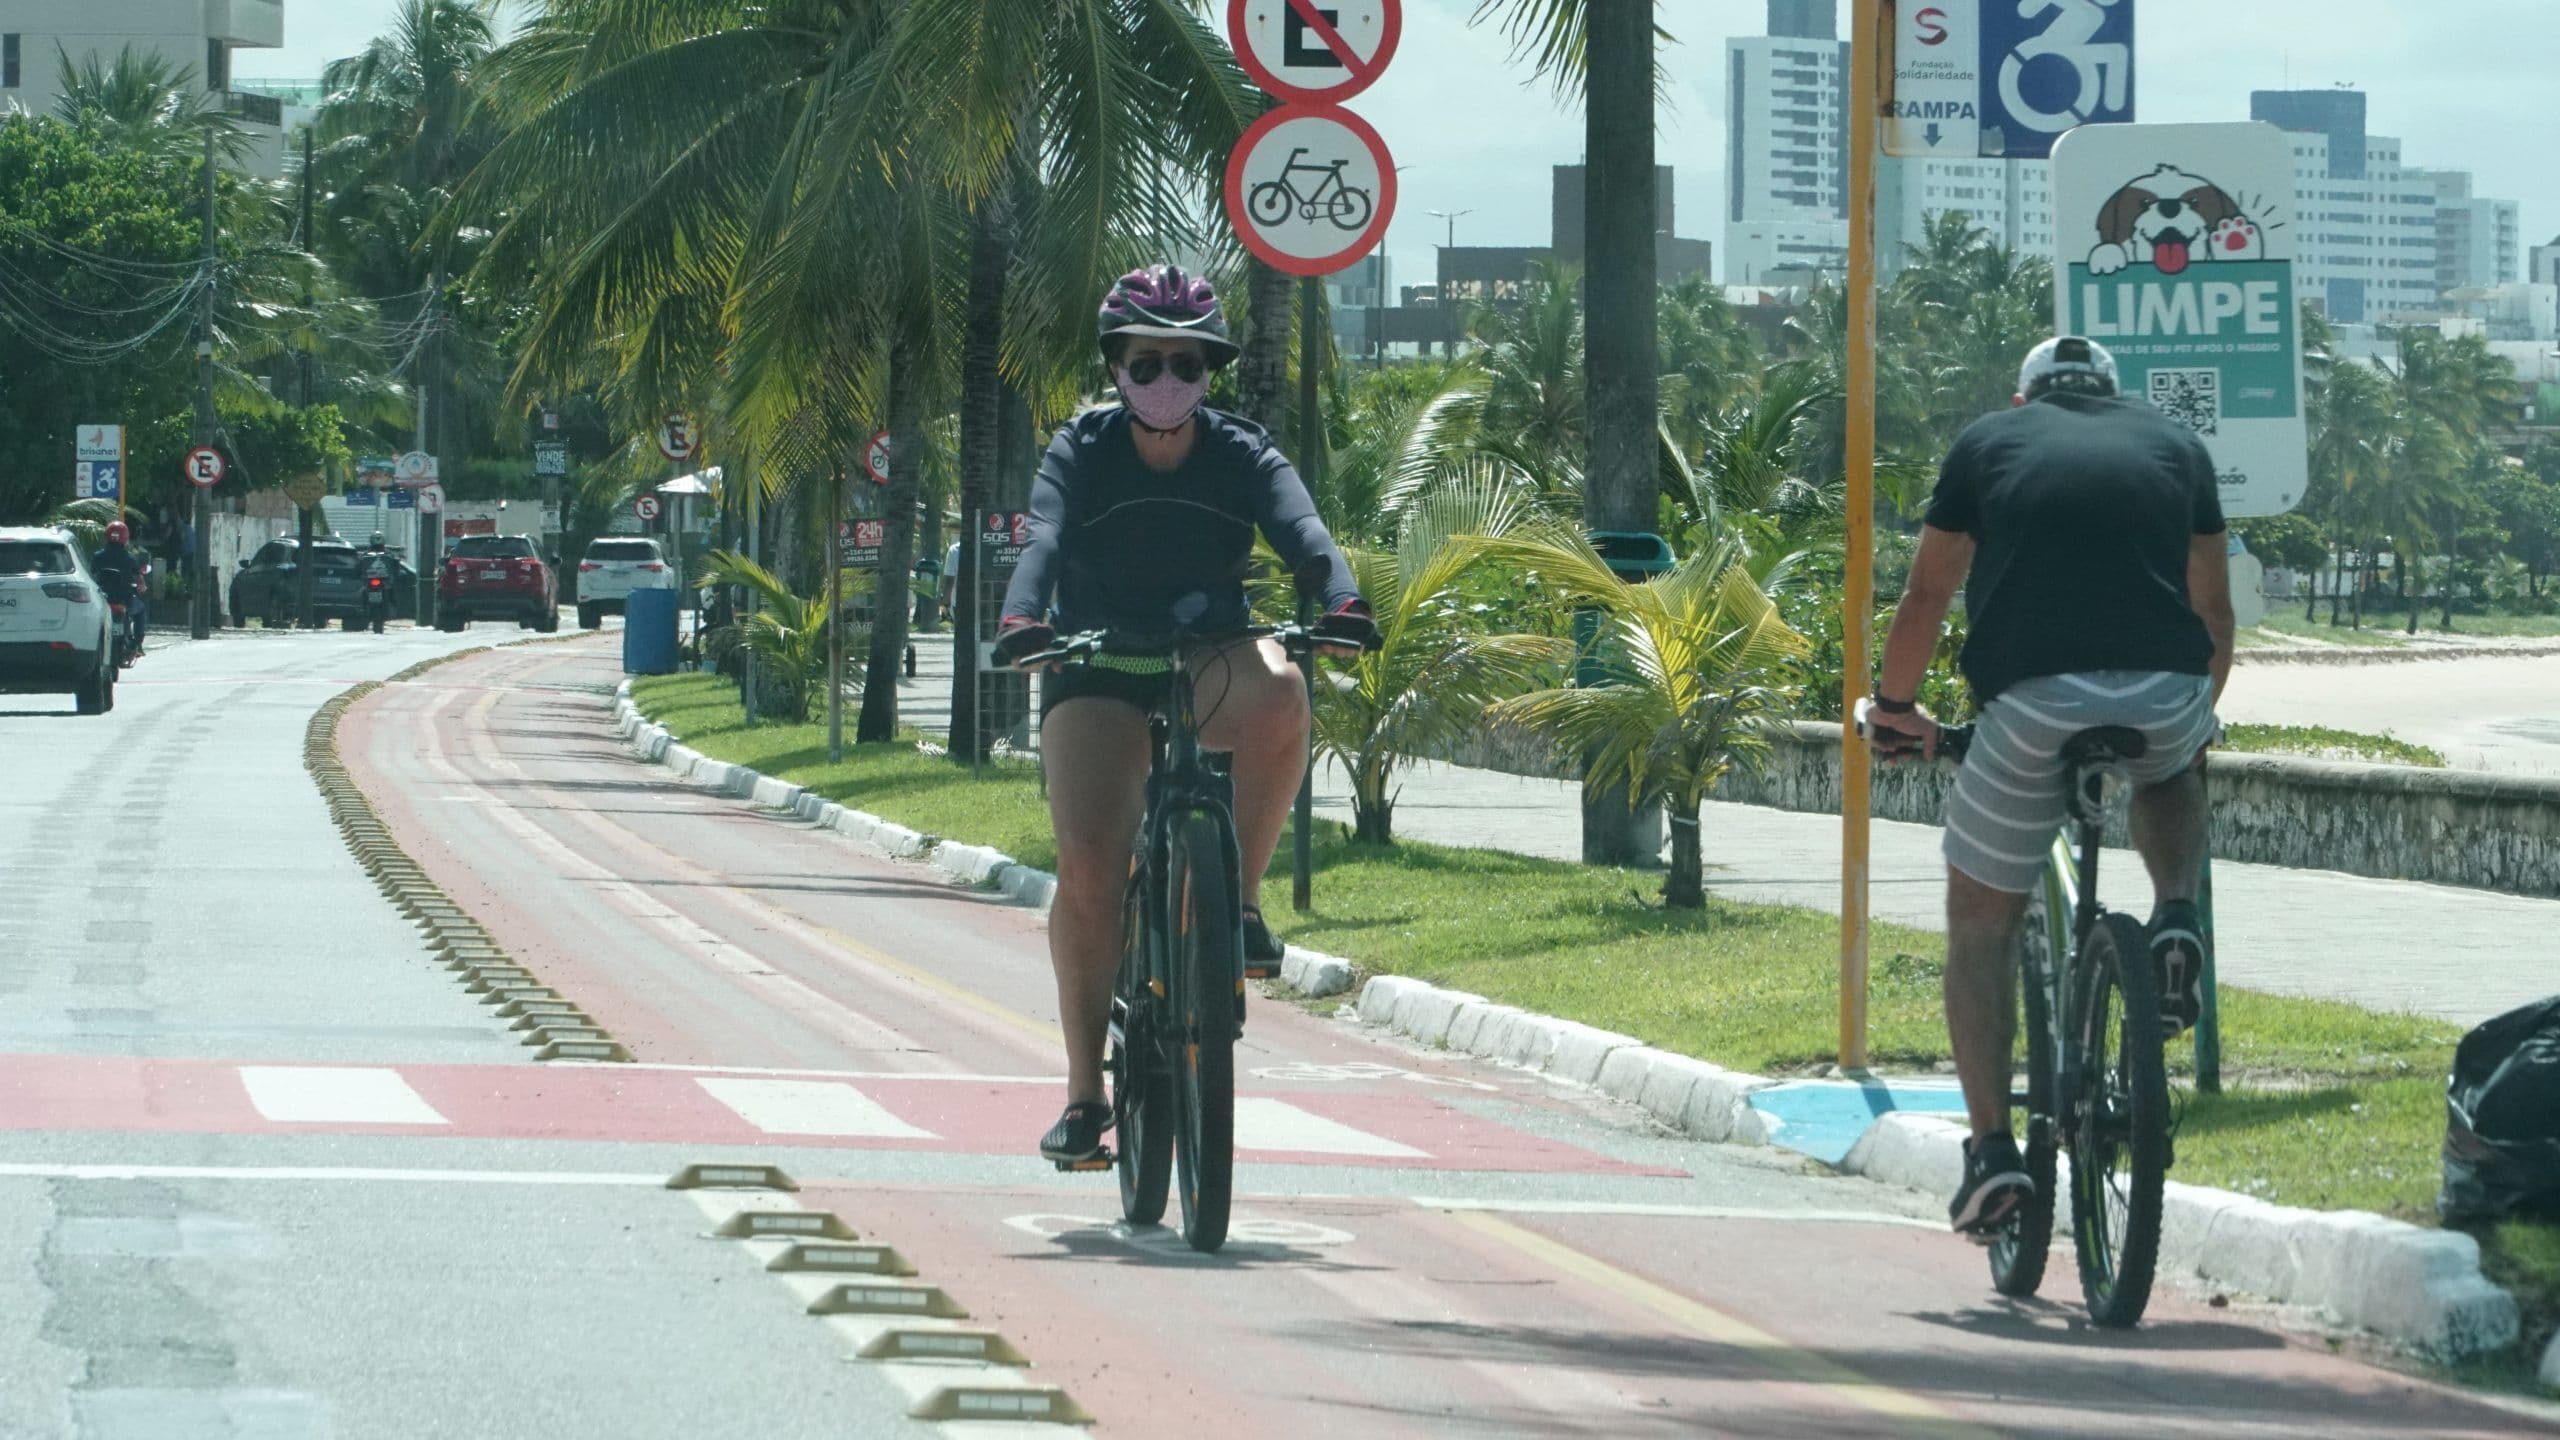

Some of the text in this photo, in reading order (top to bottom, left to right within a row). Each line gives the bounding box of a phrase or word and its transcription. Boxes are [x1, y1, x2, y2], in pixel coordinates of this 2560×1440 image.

[1911, 60, 1955, 70] Fundação
[1893, 69, 1976, 80] Solidariedade
[1893, 100, 1977, 119] RAMPA
[2082, 281, 2280, 337] LIMPE
[2135, 344, 2149, 354] DE
[2152, 344, 2172, 354] SEU
[2173, 344, 2192, 353] PET
[2225, 343, 2235, 352] O
[2237, 342, 2281, 352] PASSEIO
[856, 520, 884, 539] 24h
[1014, 513, 1029, 534] 2
[981, 532, 1011, 542] SOS
